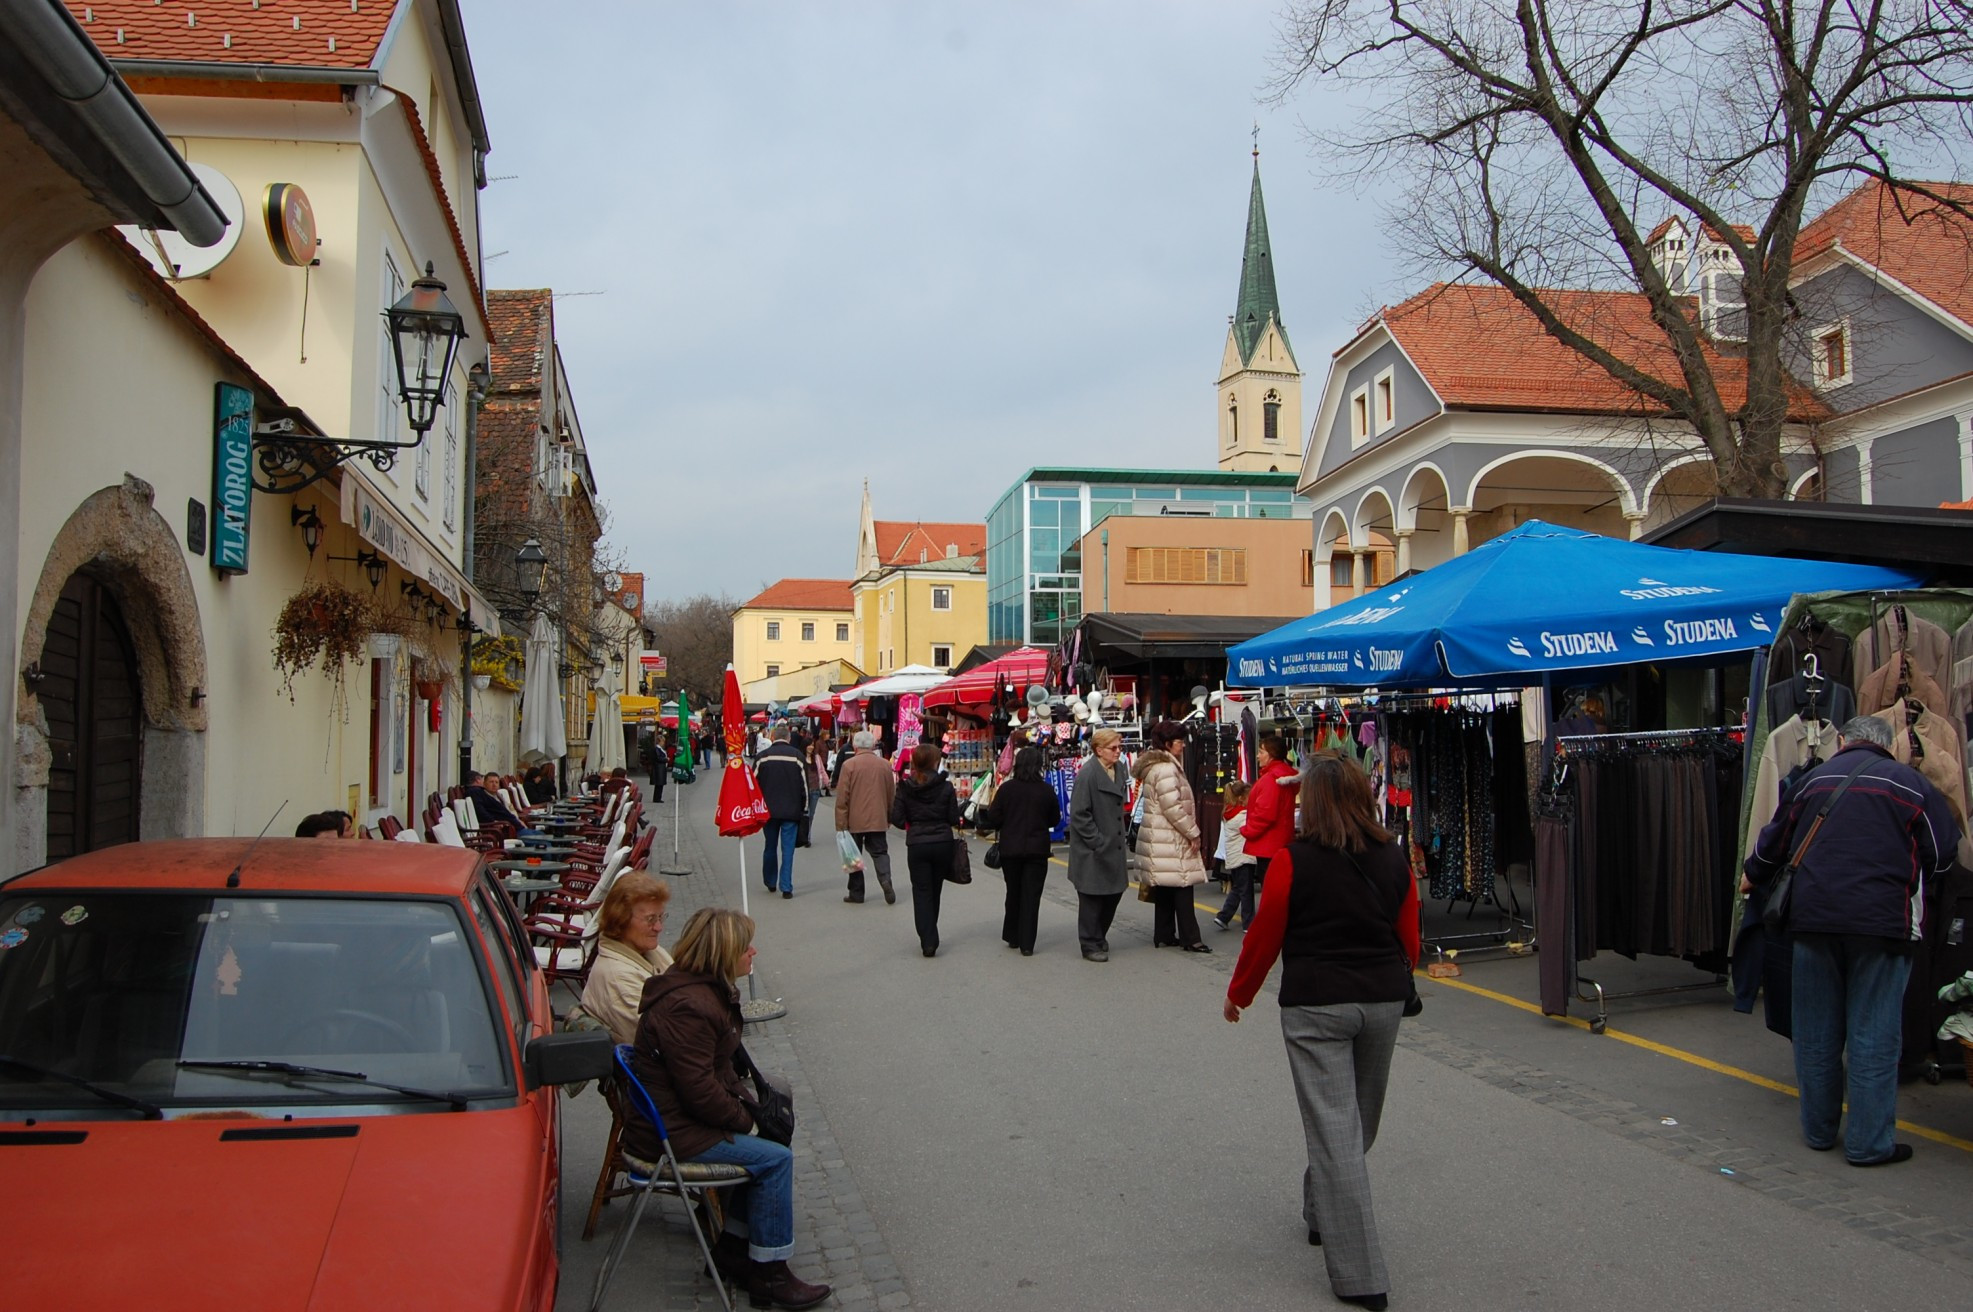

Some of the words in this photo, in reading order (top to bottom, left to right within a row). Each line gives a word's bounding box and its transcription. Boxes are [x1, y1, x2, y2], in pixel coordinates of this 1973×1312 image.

[228, 416, 248, 435] 1825
[222, 440, 248, 566] ZLATOROG
[1620, 586, 1723, 600] STUDENA
[1664, 617, 1737, 645] STUDENA
[1540, 631, 1618, 658] STUDENA
[1239, 657, 1265, 678] STUDENA
[1282, 653, 1304, 664] NATURAL
[1305, 651, 1326, 661] SPRING
[1327, 650, 1349, 660] WATER
